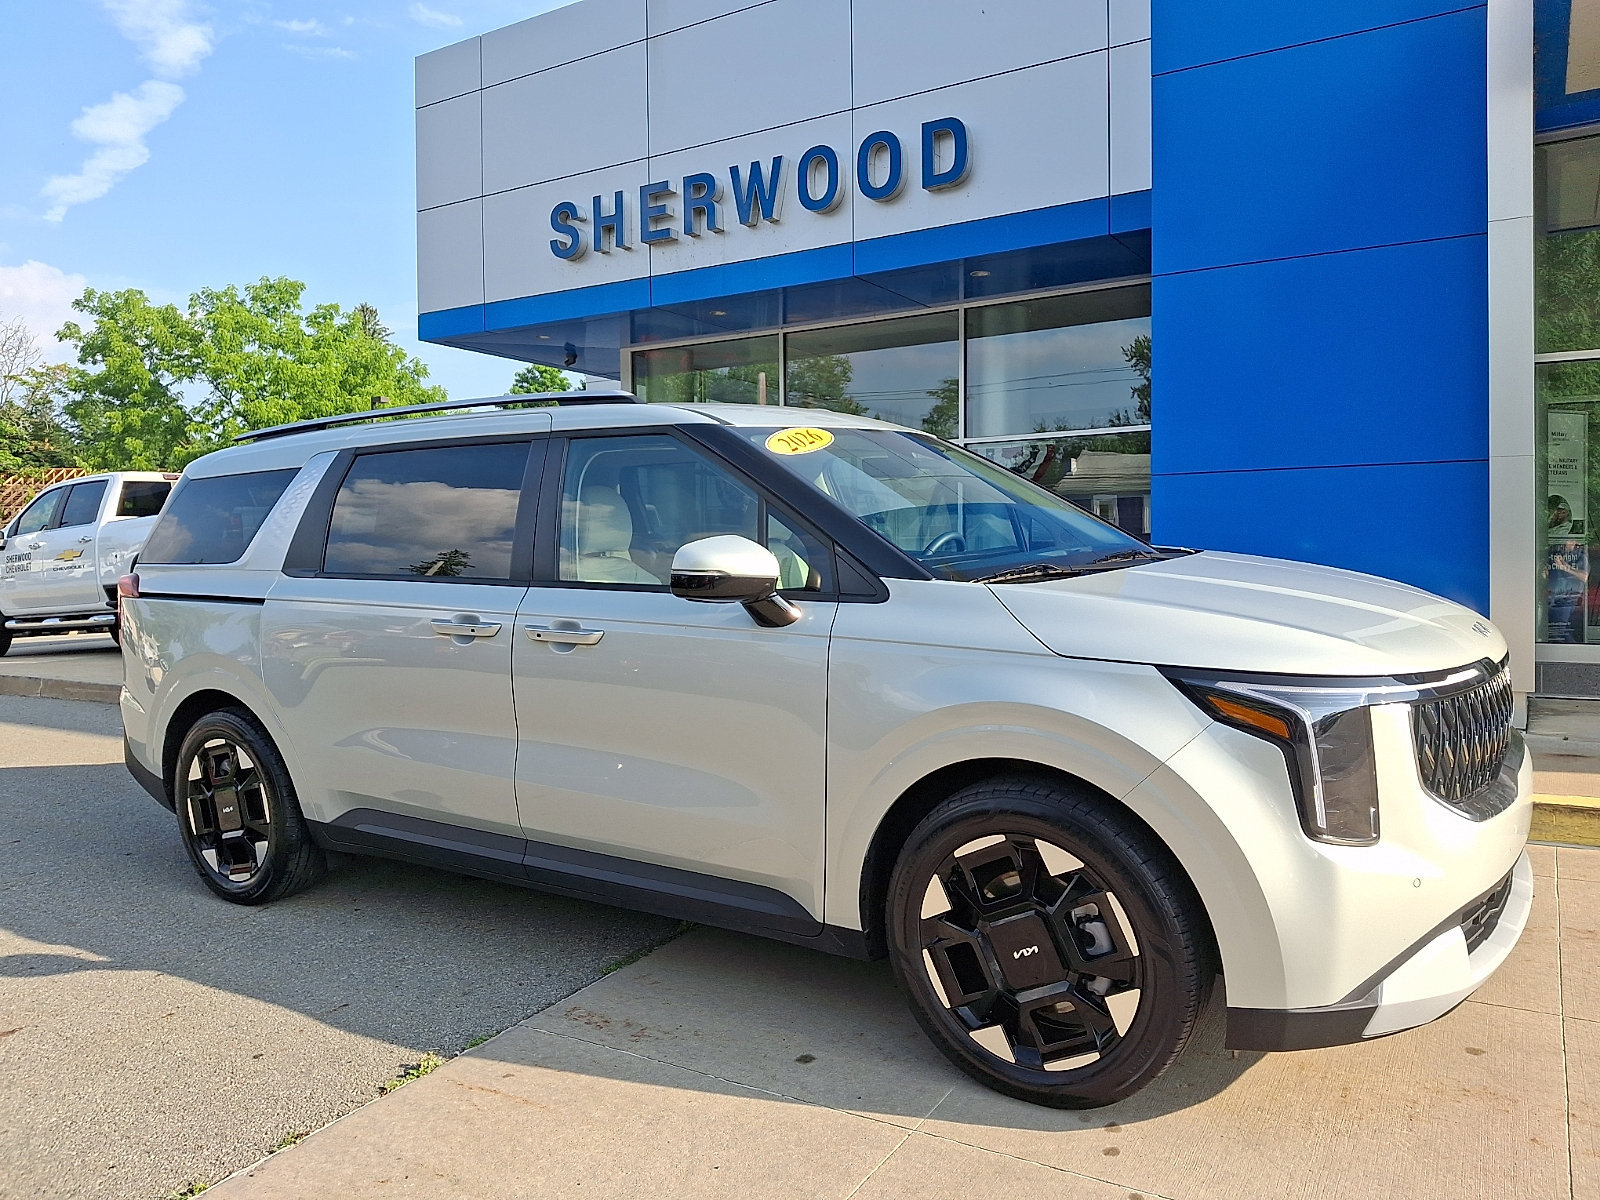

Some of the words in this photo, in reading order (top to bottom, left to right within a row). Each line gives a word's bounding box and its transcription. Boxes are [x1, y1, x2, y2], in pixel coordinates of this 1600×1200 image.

[550, 116, 972, 260] SHERWOOD
[777, 429, 824, 452] 2026
[6, 552, 32, 564] SHERWOOD
[6, 562, 32, 574] CHEVROLET
[53, 564, 86, 572] CHEVROLET
